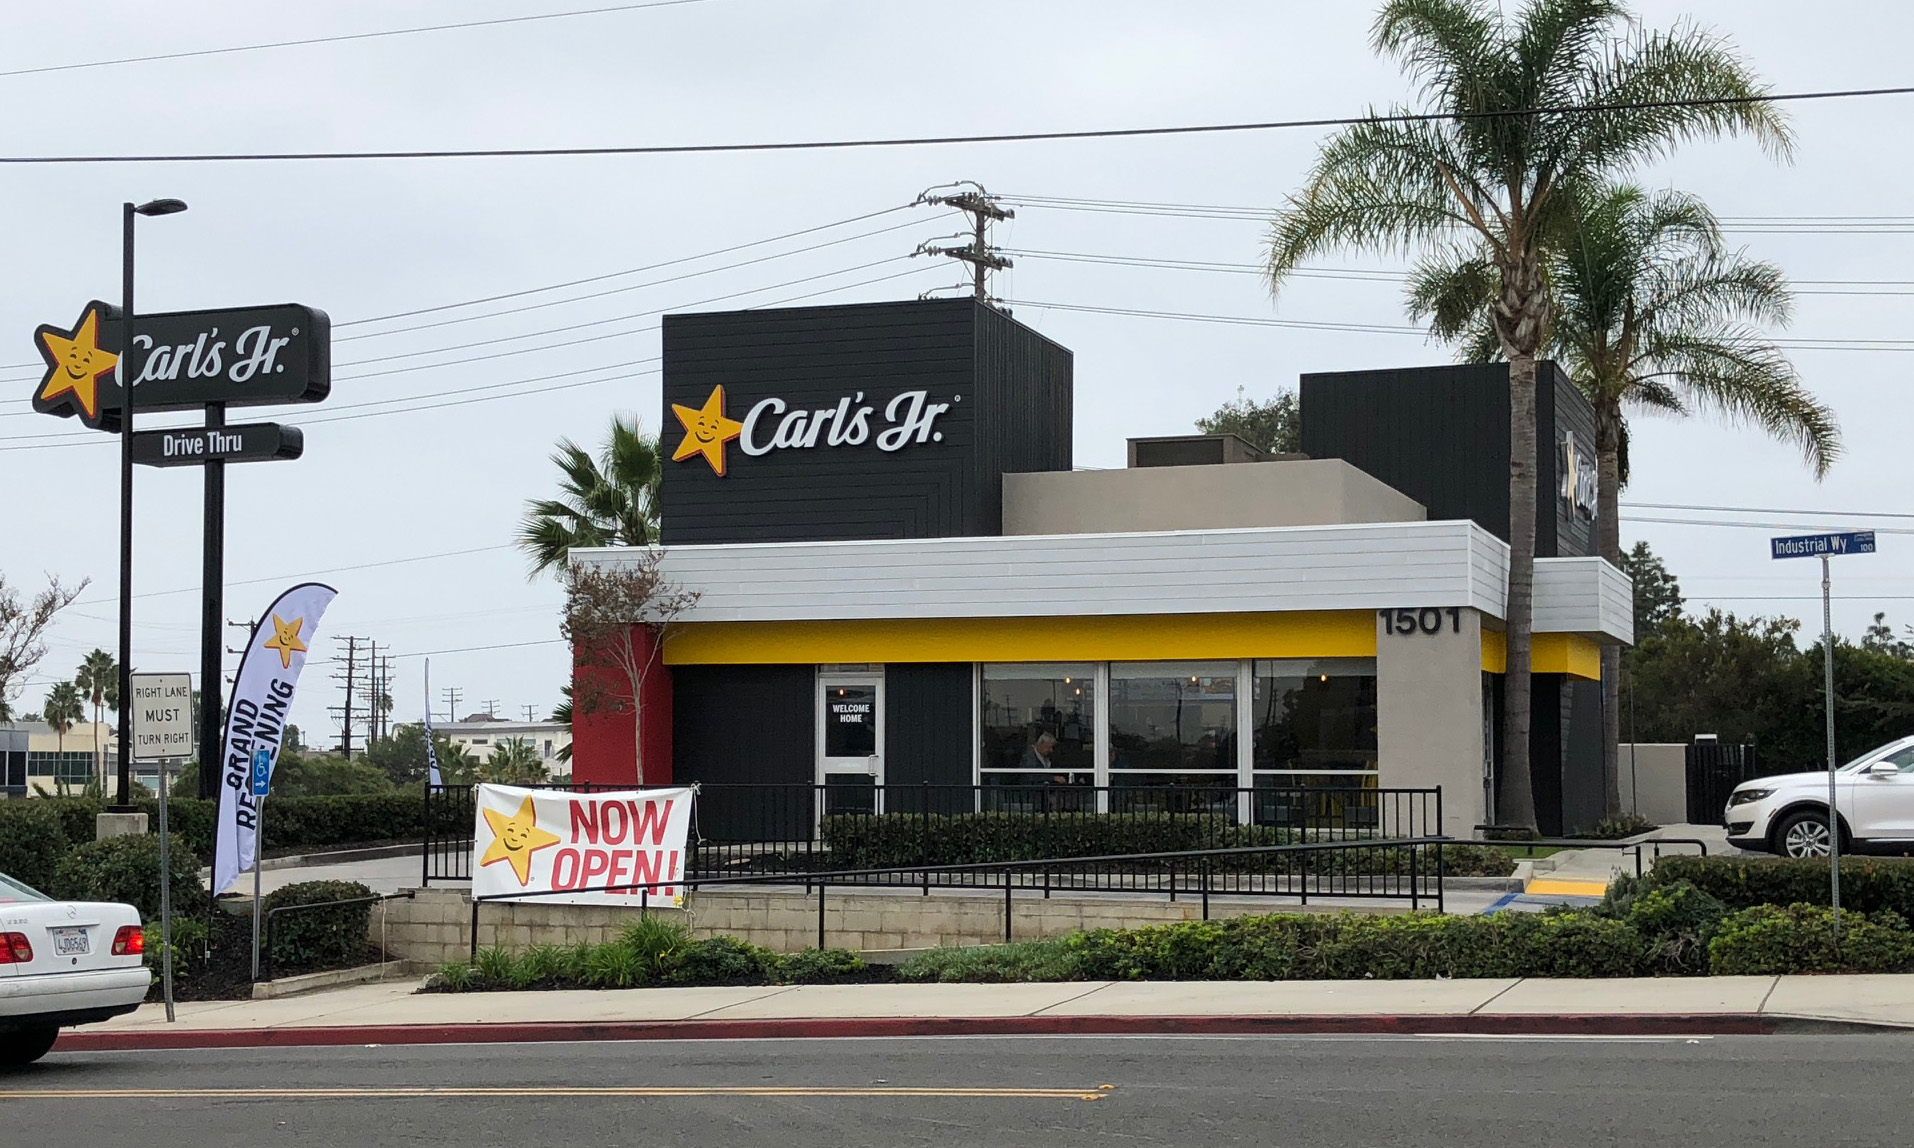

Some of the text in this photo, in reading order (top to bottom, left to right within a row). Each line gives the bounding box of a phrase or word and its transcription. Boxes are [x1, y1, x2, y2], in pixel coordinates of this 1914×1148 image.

[114, 325, 289, 388] Carl's Jr.
[740, 390, 949, 456] Carl's Jr.
[163, 431, 242, 457] Drive Thru
[1775, 537, 1828, 555] Industrial
[1830, 535, 1847, 554] Wy
[1860, 543, 1873, 552] 100
[1379, 606, 1460, 635] 1501
[136, 686, 188, 698] RIGHT LANE
[145, 708, 180, 722] MUST
[832, 704, 870, 713] WELCOME
[840, 714, 862, 723] HOME
[138, 732, 189, 745] TURN RIGHT
[569, 799, 674, 846] NOW
[551, 848, 679, 897] OPEN!
